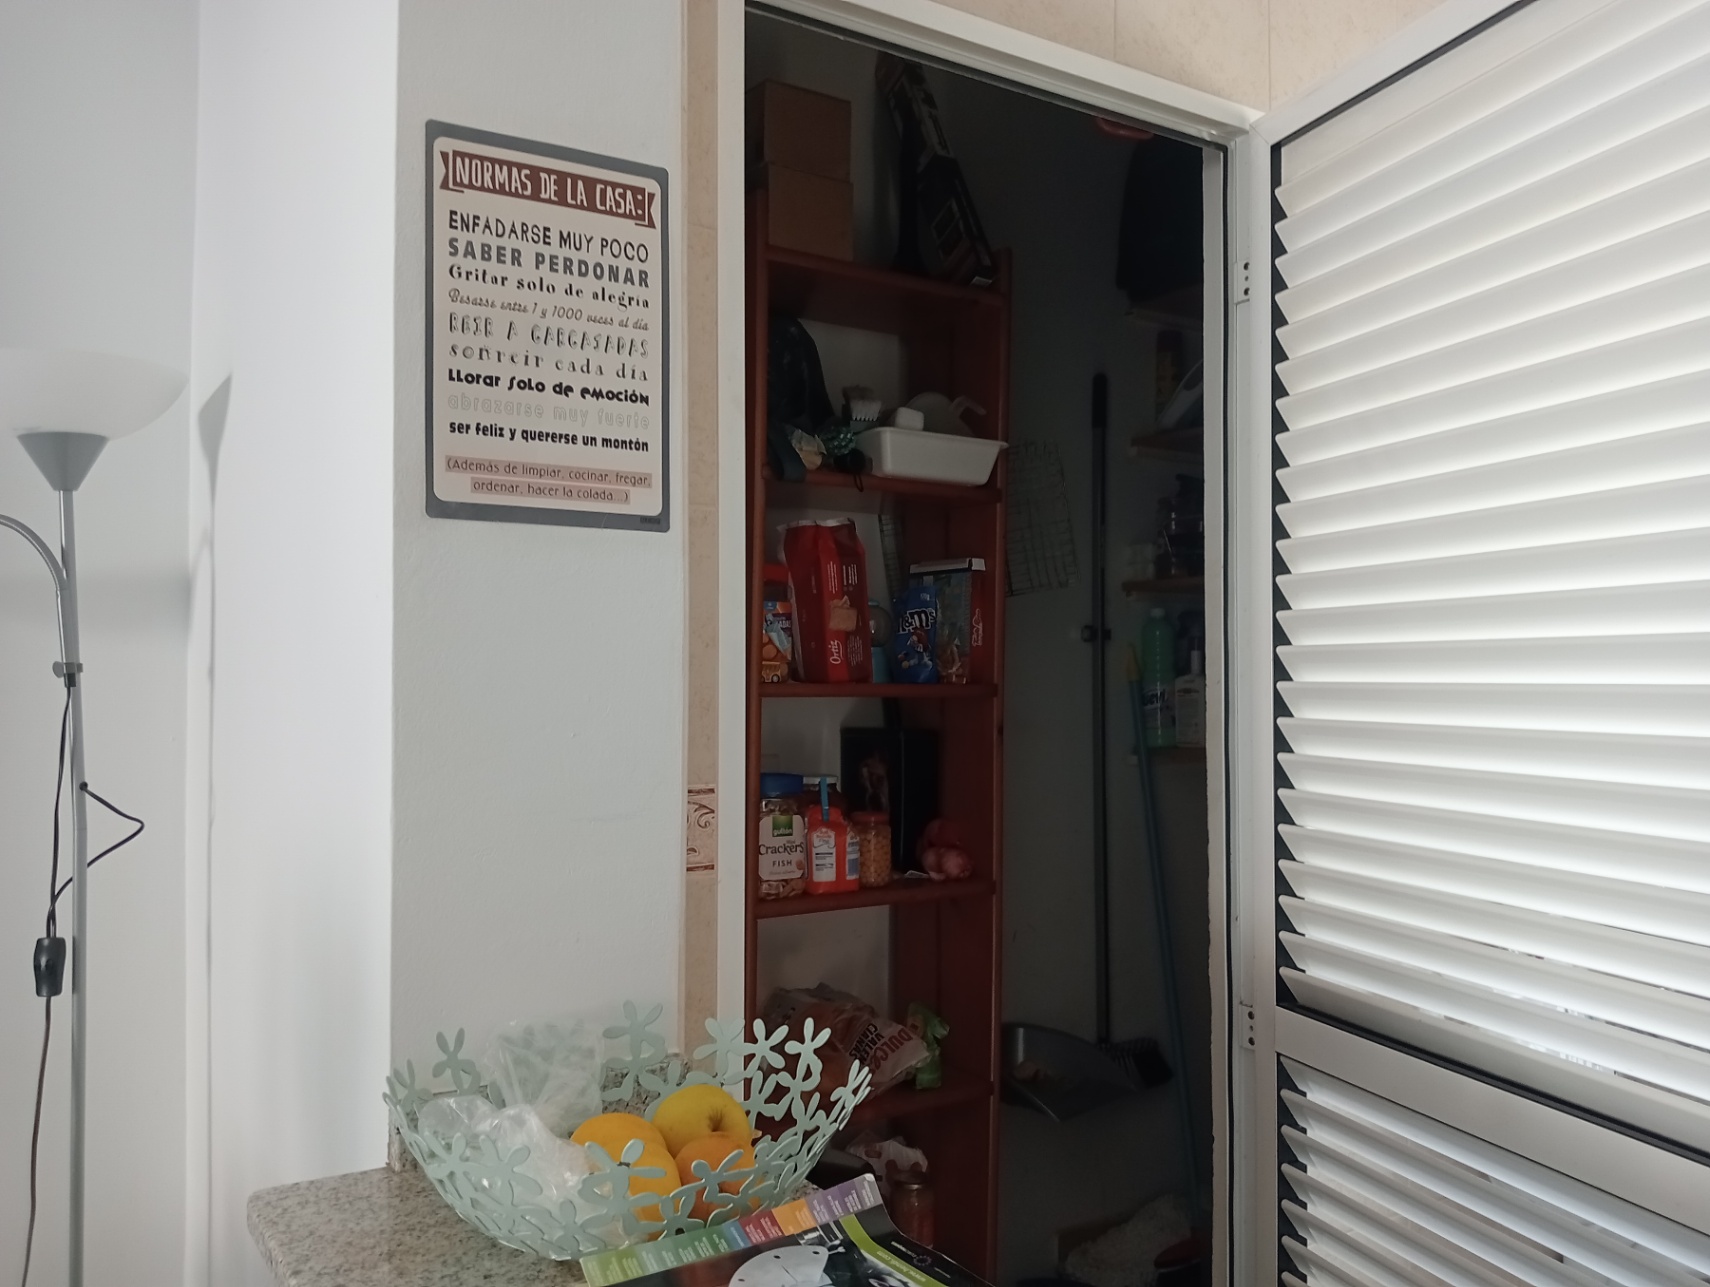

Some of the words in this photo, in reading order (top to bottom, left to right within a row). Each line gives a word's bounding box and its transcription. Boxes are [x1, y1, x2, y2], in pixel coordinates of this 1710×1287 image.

[456, 157, 531, 196] NORMAS
[540, 172, 559, 201] DE
[567, 178, 587, 207] LA
[596, 184, 643, 217] CASA:
[449, 210, 551, 246] ENFADARSE
[559, 230, 593, 253] MUY
[601, 238, 648, 263] POCO
[449, 237, 522, 267] SABER
[536, 252, 649, 288] PERDONAR
[449, 263, 508, 286] Gritar
[516, 276, 555, 295] solo
[565, 283, 583, 298] de
[501, 301, 529, 314] entre
[532, 302, 538, 314] 1
[540, 307, 547, 319] y
[552, 305, 582, 321] 1000
[618, 316, 629, 328] al
[507, 320, 518, 341] A
[555, 357, 604, 377] cada
[552, 382, 574, 397] de
[447, 392, 544, 419] abrazarse
[553, 405, 588, 427] muy
[597, 408, 650, 430] fuerte
[449, 421, 471, 435] ser
[475, 422, 505, 438] feliz
[509, 428, 516, 441] y
[521, 429, 578, 446] quererse
[582, 434, 597, 447] un
[601, 438, 649, 452] montón
[447, 457, 500, 473] (Además
[504, 463, 518, 475] de
[522, 464, 564, 480] limpiar,
[568, 469, 611, 484] cocinar,
[615, 472, 651, 488] fregar,
[473, 480, 523, 495] ordenar,
[528, 483, 559, 497] hacer
[563, 486, 574, 499] la
[829, 639, 845, 665] Ortiz
[758, 841, 805, 856] Crackers
[772, 859, 792, 867] FISH
